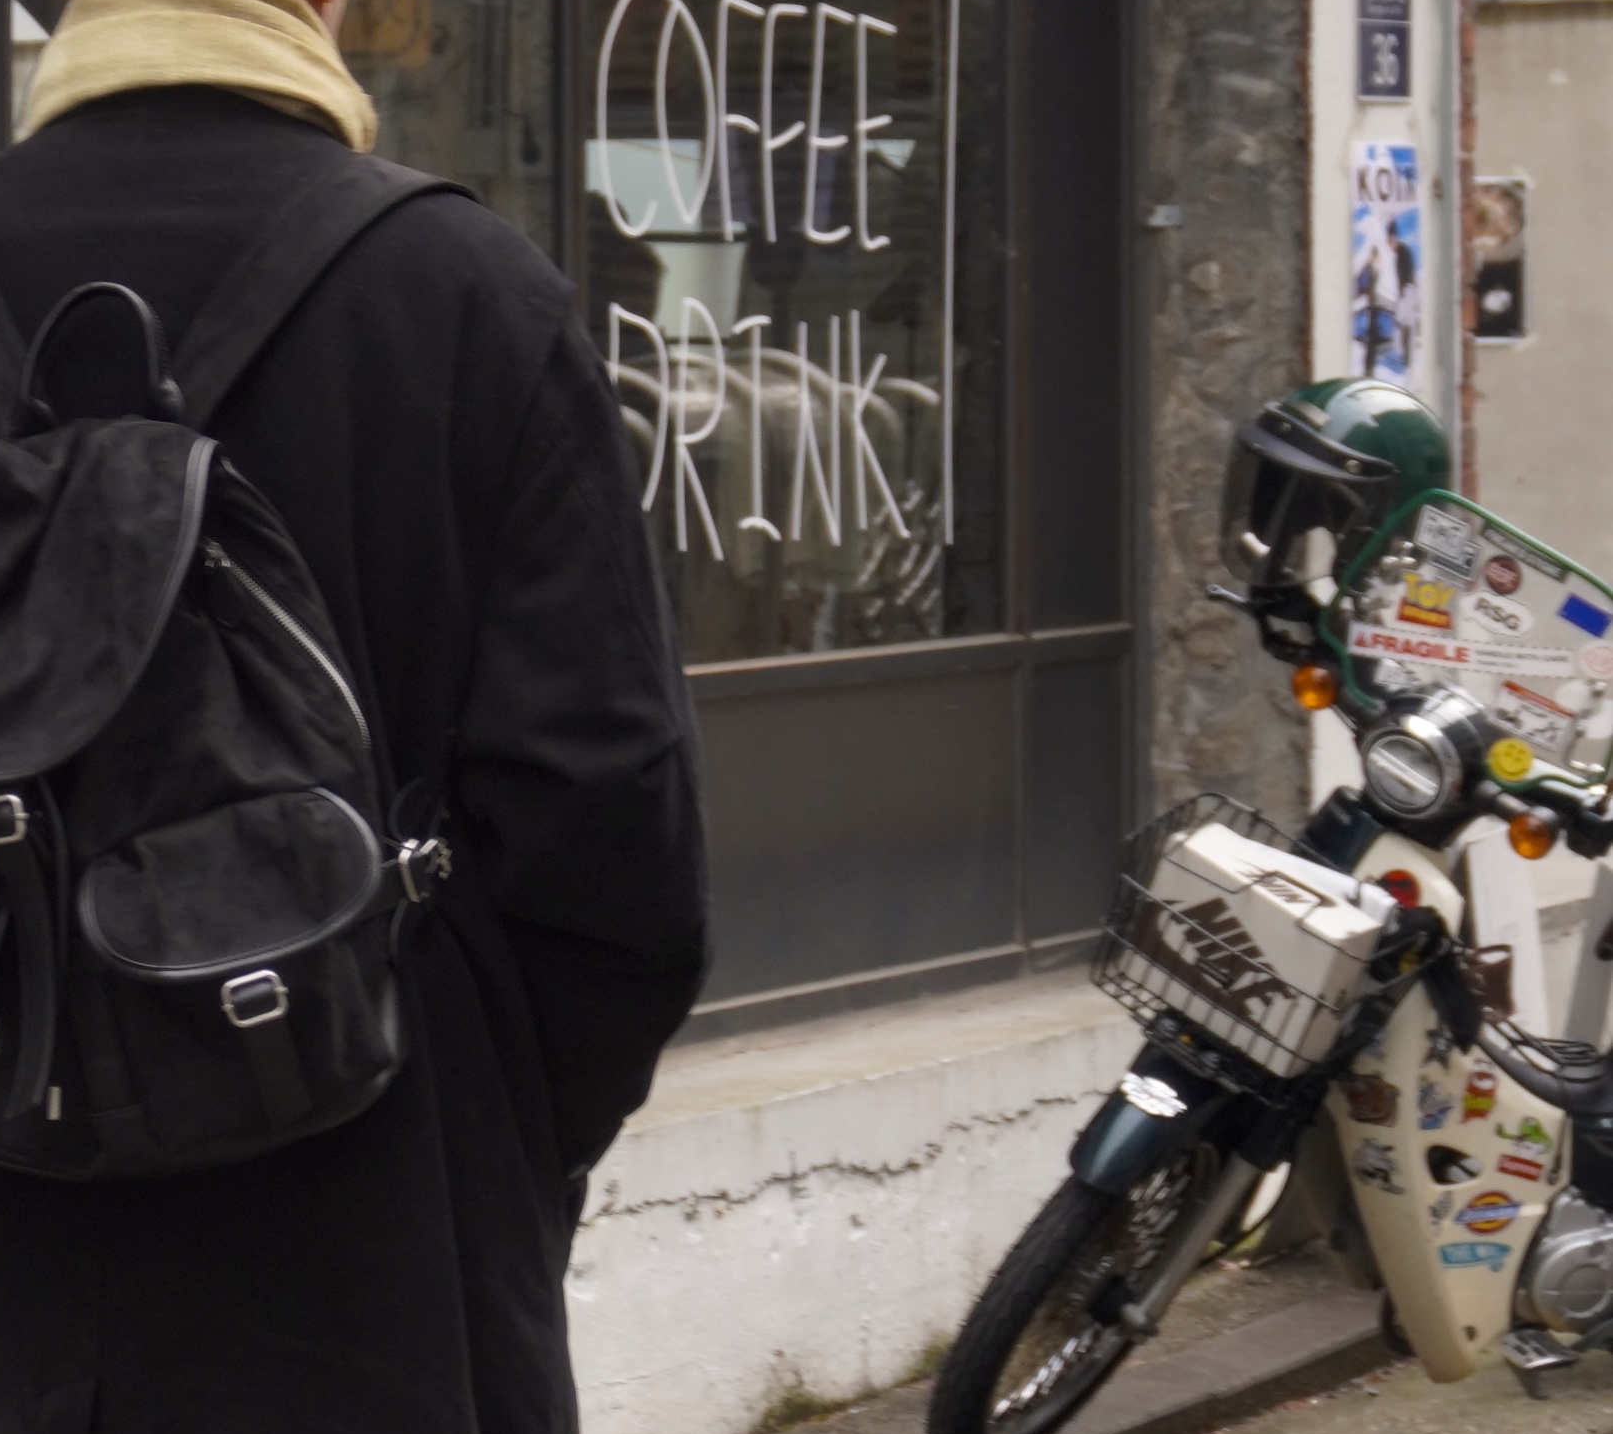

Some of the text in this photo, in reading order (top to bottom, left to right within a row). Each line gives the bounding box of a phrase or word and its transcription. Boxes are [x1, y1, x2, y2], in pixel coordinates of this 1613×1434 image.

[609, 296, 912, 562] DRINK
[1370, 632, 1470, 664] FRAGILE
[1170, 896, 1297, 1020] NIKE
